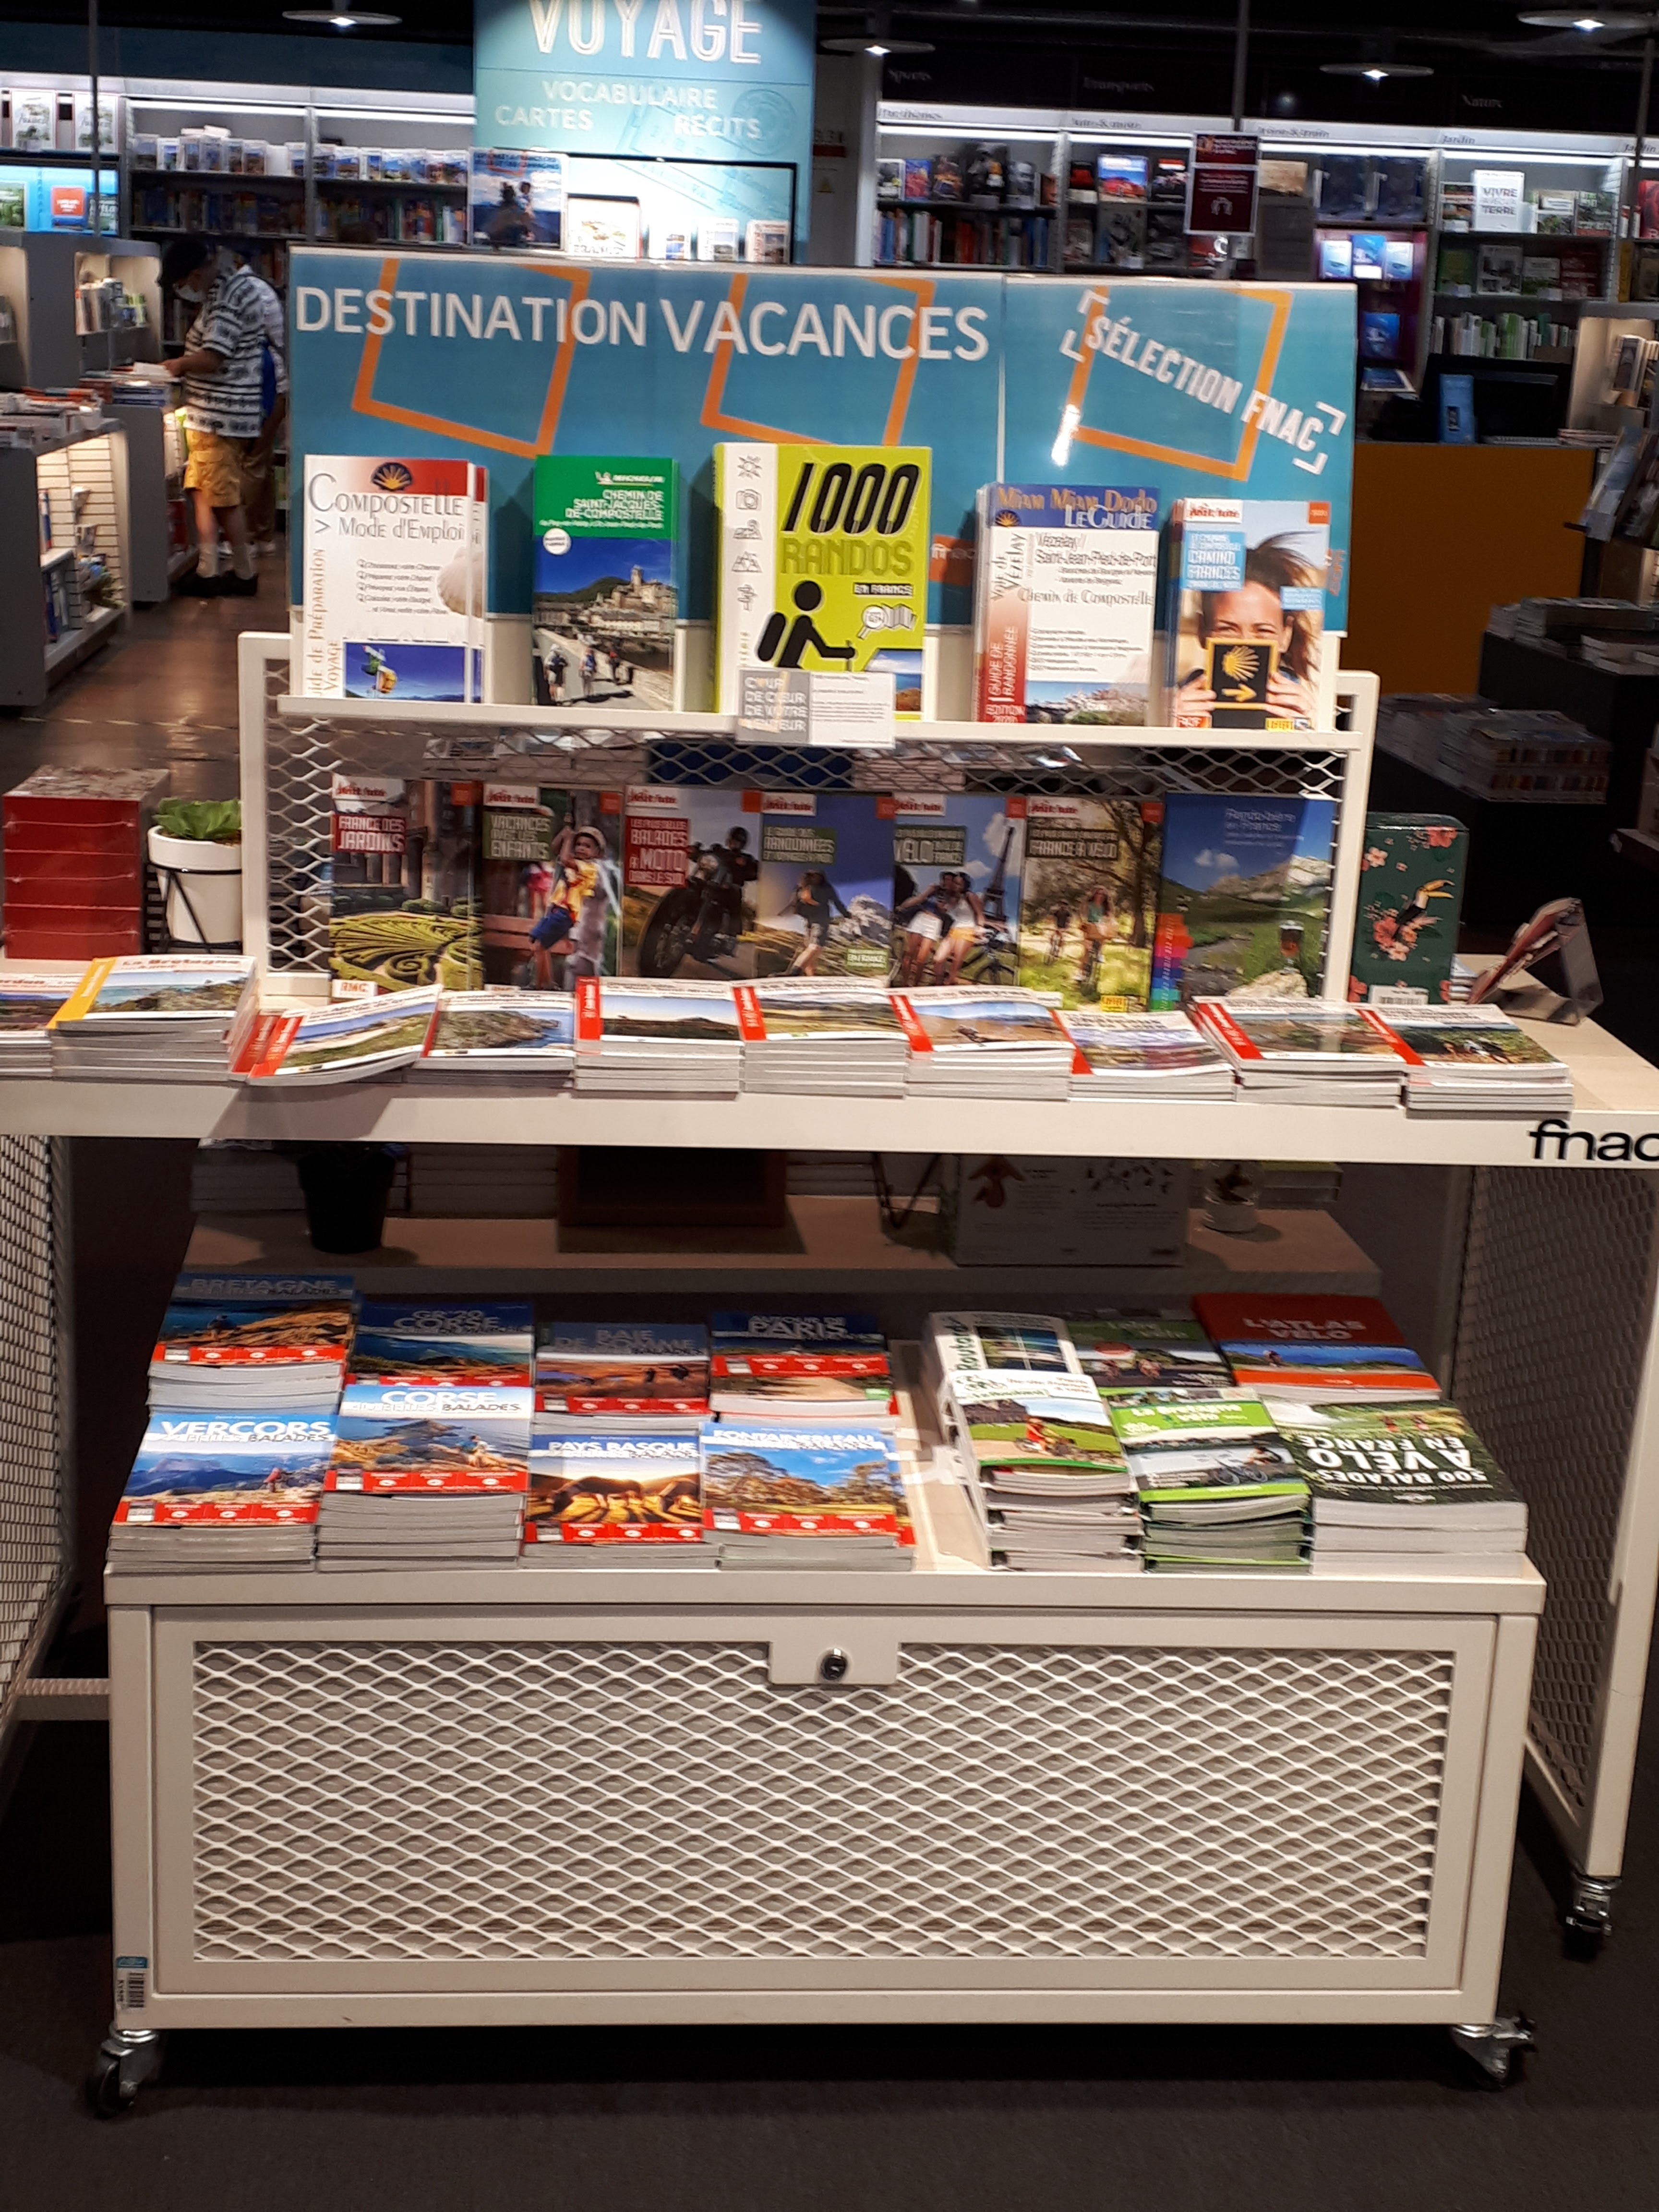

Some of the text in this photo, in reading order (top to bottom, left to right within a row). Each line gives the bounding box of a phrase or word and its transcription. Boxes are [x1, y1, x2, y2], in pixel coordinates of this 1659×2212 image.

[529, 0, 762, 64] VOYAGE
[541, 79, 718, 109] VOCABULAIRE
[494, 105, 594, 132] CARTES
[1443, 135, 1476, 144] Jardin
[1482, 187, 1518, 197] VIVRE
[1481, 205, 1518, 216] TERRE
[295, 286, 990, 361] DESTINATION VACANCES
[1086, 316, 1324, 452] SÉLECTION FNAC
[602, 490, 664, 501] CHEMIN DE
[781, 462, 920, 534] 1000
[1105, 489, 1157, 513] Dodo
[338, 517, 387, 538] Mode
[781, 538, 914, 576] RANDOS
[1187, 550, 1236, 565] CAMINO
[854, 584, 914, 596] EN FRANCE
[988, 642, 1003, 696] GUIDE DE
[745, 690, 765, 703] DE
[745, 704, 765, 717] DE
[765, 705, 808, 718] VTRE
[338, 816, 405, 833] FRANCE DES
[491, 815, 551, 833] VACANCES
[337, 830, 406, 852] JARDINS
[630, 829, 688, 847] BALADES
[491, 839, 551, 860] ENFANTS
[1029, 840, 1076, 856] FRANCE
[639, 848, 688, 871] MOTO
[1529, 1119, 1659, 1161] fnac
[191, 1278, 338, 1289] BRETAGNE
[393, 1316, 501, 1330] CORSE
[749, 1321, 849, 1338] PARIS
[1241, 1317, 1368, 1331] L'ATLAS
[596, 1329, 654, 1340] BAIE
[381, 1390, 498, 1405] CORSE
[441, 1403, 522, 1412] BALADES
[159, 1419, 332, 1435] VERCORS
[248, 1433, 331, 1442] BALADES
[713, 1429, 875, 1444] FONTAINEBLEAU
[1298, 1435, 1466, 1452] EN FRANCE
[548, 1441, 698, 1453] PAYS BASQUE
[1306, 1448, 1439, 1474] VÉLO
[1315, 1468, 1489, 1485] 500 BALADES
